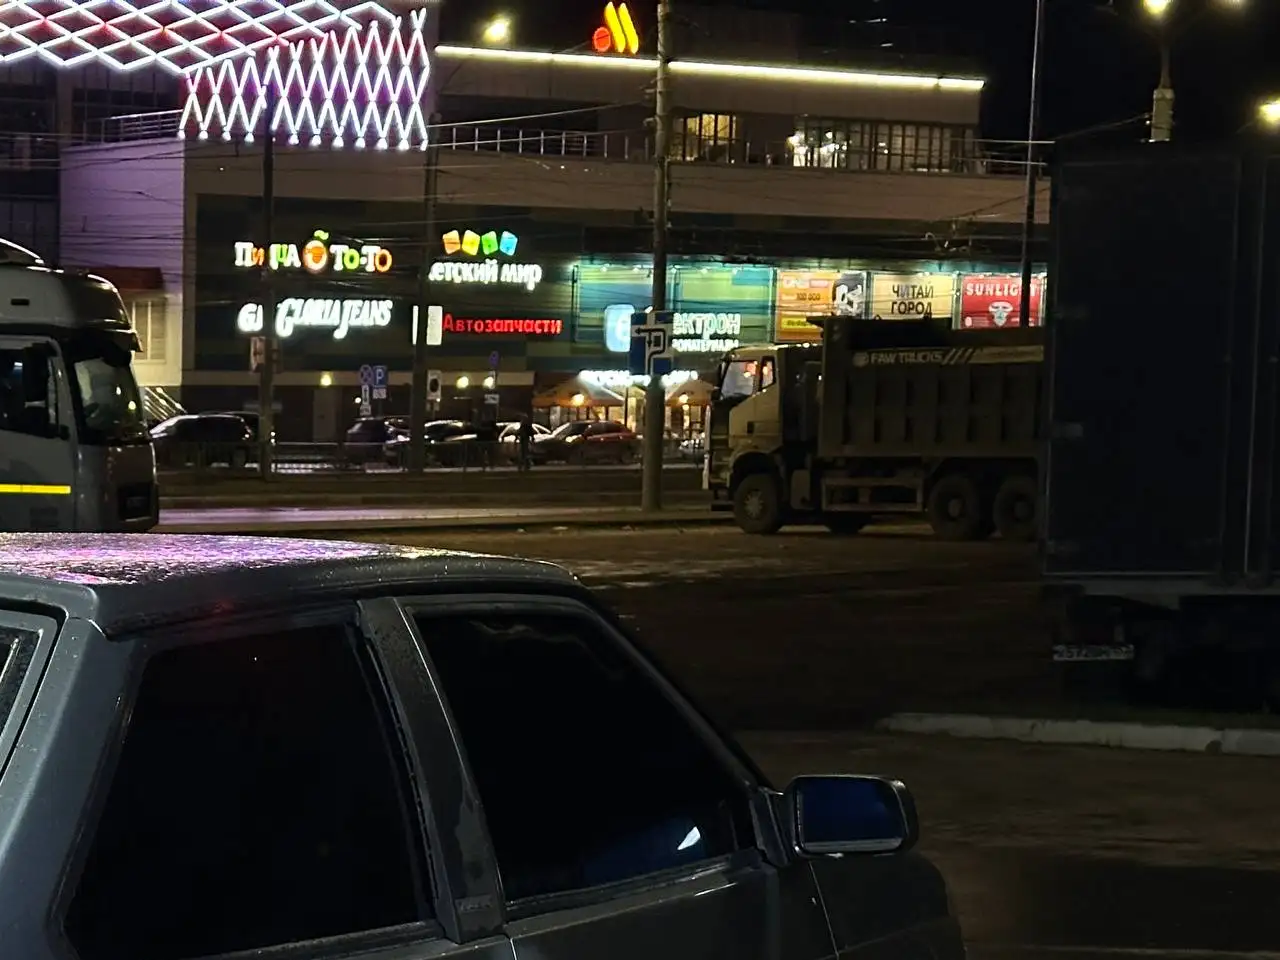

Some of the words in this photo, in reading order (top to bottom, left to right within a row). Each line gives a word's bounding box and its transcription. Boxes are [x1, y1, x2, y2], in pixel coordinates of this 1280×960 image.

[428, 259, 499, 284] етский
[501, 264, 543, 290] мир
[891, 283, 935, 299] ЧИТАЙ
[966, 282, 1037, 297] SUNLIGT
[890, 301, 933, 319] ГОРОД
[443, 313, 563, 334] Автозапчасти
